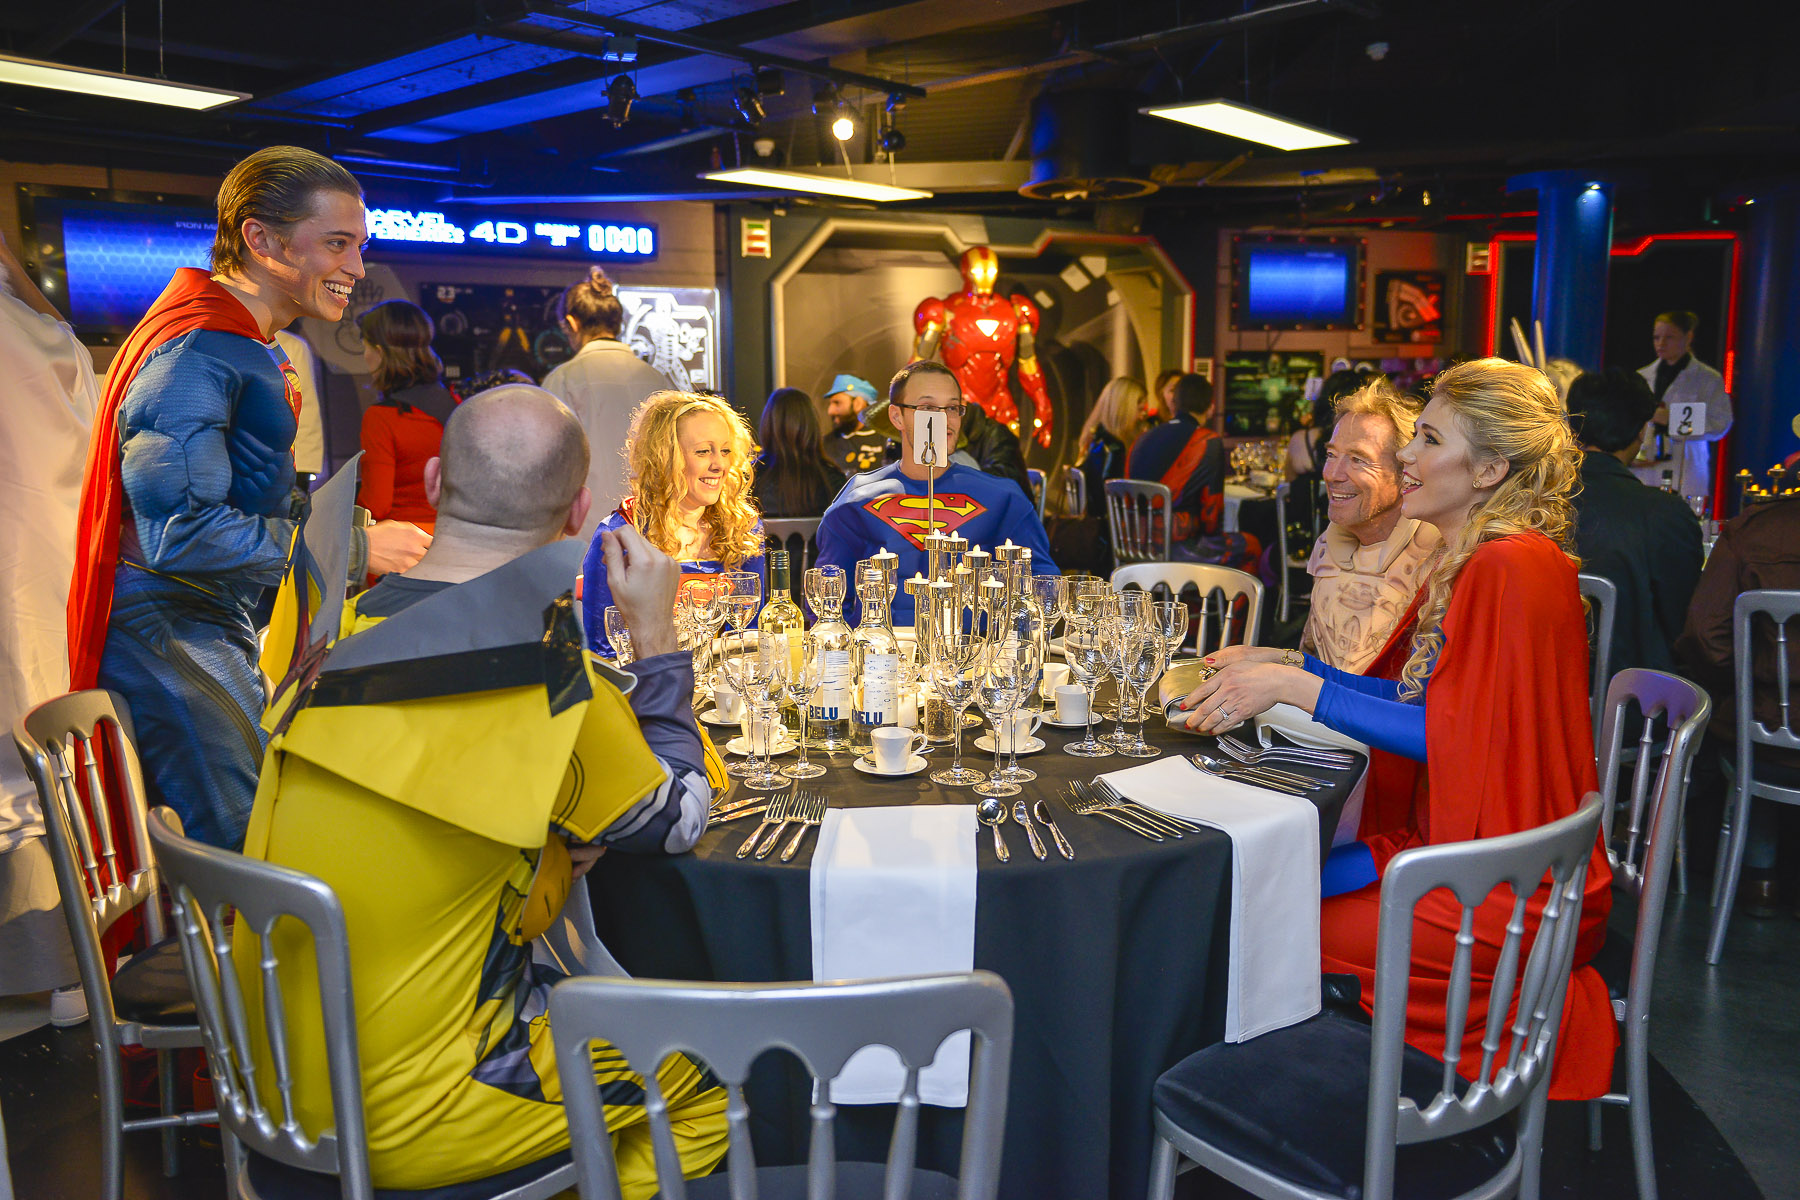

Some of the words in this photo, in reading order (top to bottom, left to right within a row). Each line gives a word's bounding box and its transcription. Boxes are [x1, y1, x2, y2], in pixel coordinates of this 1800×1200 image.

[469, 220, 528, 244] 4D
[1681, 406, 1693, 425] 2
[926, 416, 933, 450] 1
[809, 704, 838, 721] BELU
